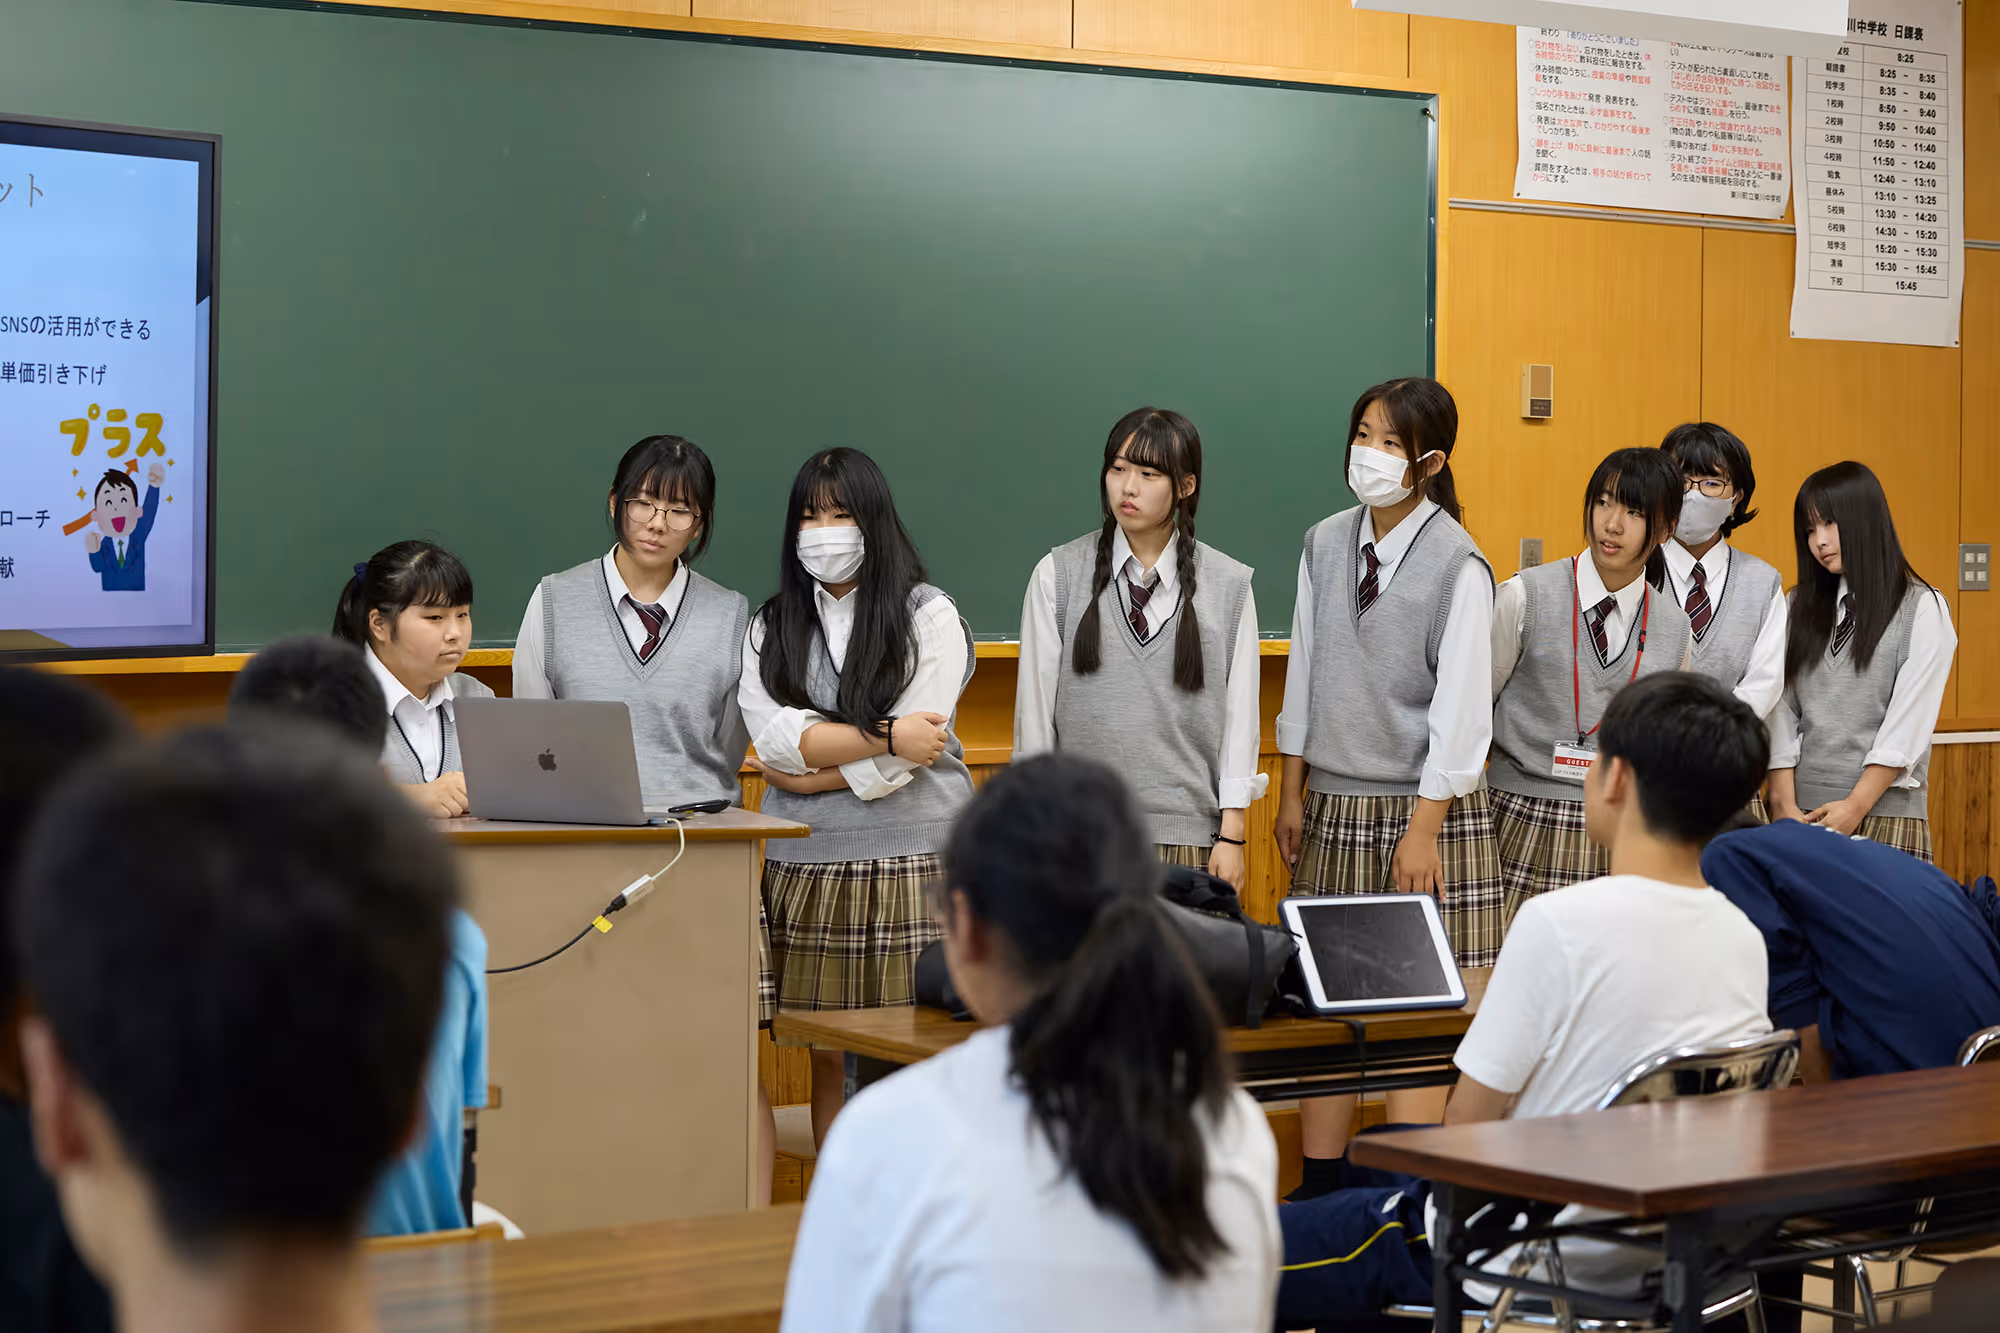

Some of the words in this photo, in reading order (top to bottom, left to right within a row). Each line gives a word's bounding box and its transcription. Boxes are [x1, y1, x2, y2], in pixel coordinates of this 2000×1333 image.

[1895, 25, 1924, 41] 日課表
[1897, 53, 1914, 63] 8:25
[1880, 68, 1896, 78] 8:25
[1919, 74, 1935, 83] 8:35
[1825, 81, 1845, 90] 短学活
[1880, 86, 1896, 96] 8:35
[1920, 91, 1936, 101] 8:40
[1879, 104, 1896, 114] 8:50
[1920, 108, 1936, 118] 9:40
[1826, 117, 1843, 126] 2校時
[1878, 122, 1895, 131] 9:50
[1915, 125, 1936, 135] 10:40
[1825, 134, 1843, 144] 3校時
[1873, 139, 1895, 149] 10:50
[1914, 143, 1936, 153] 11:40
[1824, 152, 1842, 162] 4校時
[1873, 156, 1895, 166] 11:50
[1914, 160, 1936, 170] 12:40
[1828, 170, 1841, 179] 給食
[1874, 174, 1895, 184] 12:40
[1914, 178, 1936, 188] 13:10
[1826, 187, 1845, 196] 昼休み
[1875, 192, 1896, 201] 13:10
[1915, 195, 1936, 205] 13:25
[1828, 205, 1845, 215] 5校時
[1875, 209, 1896, 219] 13:30
[1915, 212, 1937, 222] 14:20
[1828, 223, 1845, 232] 6校時
[1875, 227, 1896, 236] 14:30
[1916, 230, 1937, 240] 15:20
[1827, 241, 1846, 250] 短学活
[1875, 244, 1897, 254] 15:20
[1916, 248, 1937, 257] 15:30
[1830, 259, 1843, 268] 清掃
[1875, 262, 1897, 272] 15:30
[1916, 265, 1937, 274] 15:45
[1830, 277, 1843, 286] 下校
[1896, 281, 1917, 291] 15:45
[0, 315, 150, 340] SNSの活用ができる
[0, 361, 107, 386] 単価引き下げ
[60, 403, 165, 458] プラス
[0, 509, 50, 529] ローチ
